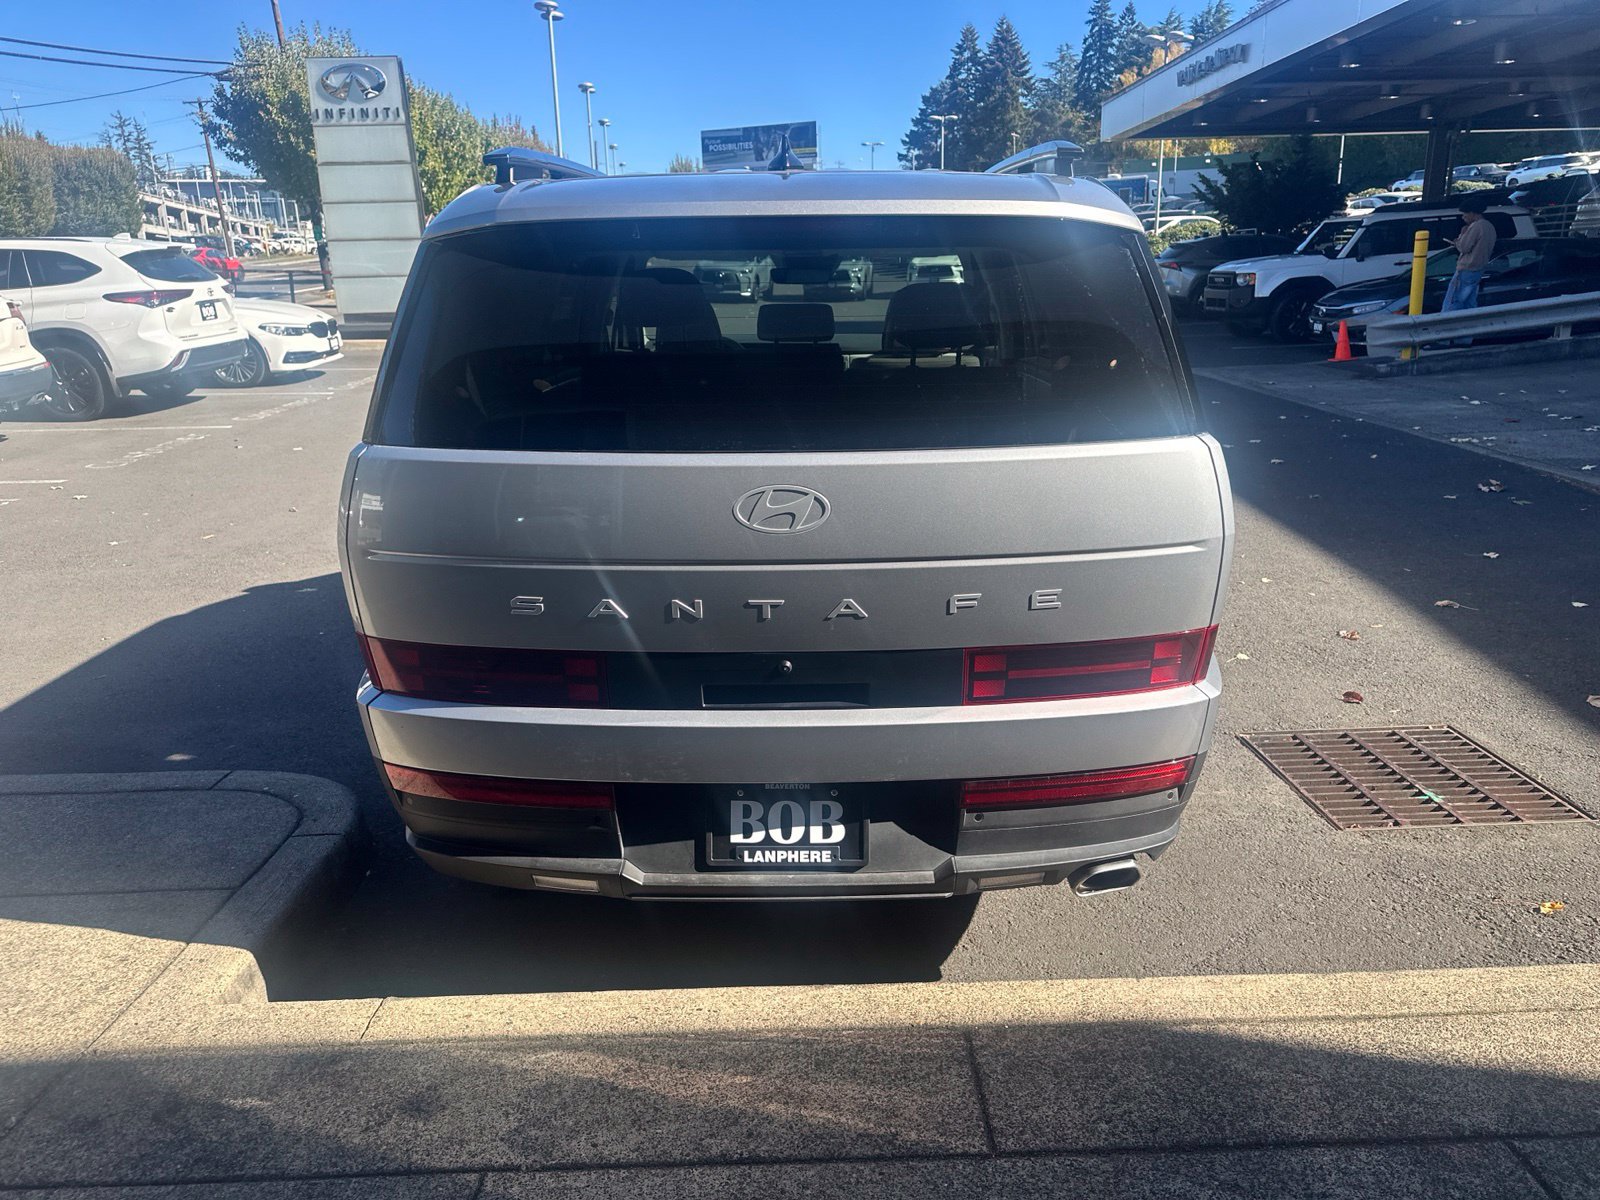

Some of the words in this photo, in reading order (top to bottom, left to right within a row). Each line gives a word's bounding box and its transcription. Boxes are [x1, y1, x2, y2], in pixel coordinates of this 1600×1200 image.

[314, 106, 400, 120] INFINITI
[708, 141, 754, 152] POSSIBILITIES
[509, 595, 869, 620] SANTA
[948, 588, 1063, 614] FE
[730, 800, 846, 844] BOB
[743, 850, 832, 863] LANPHERE
